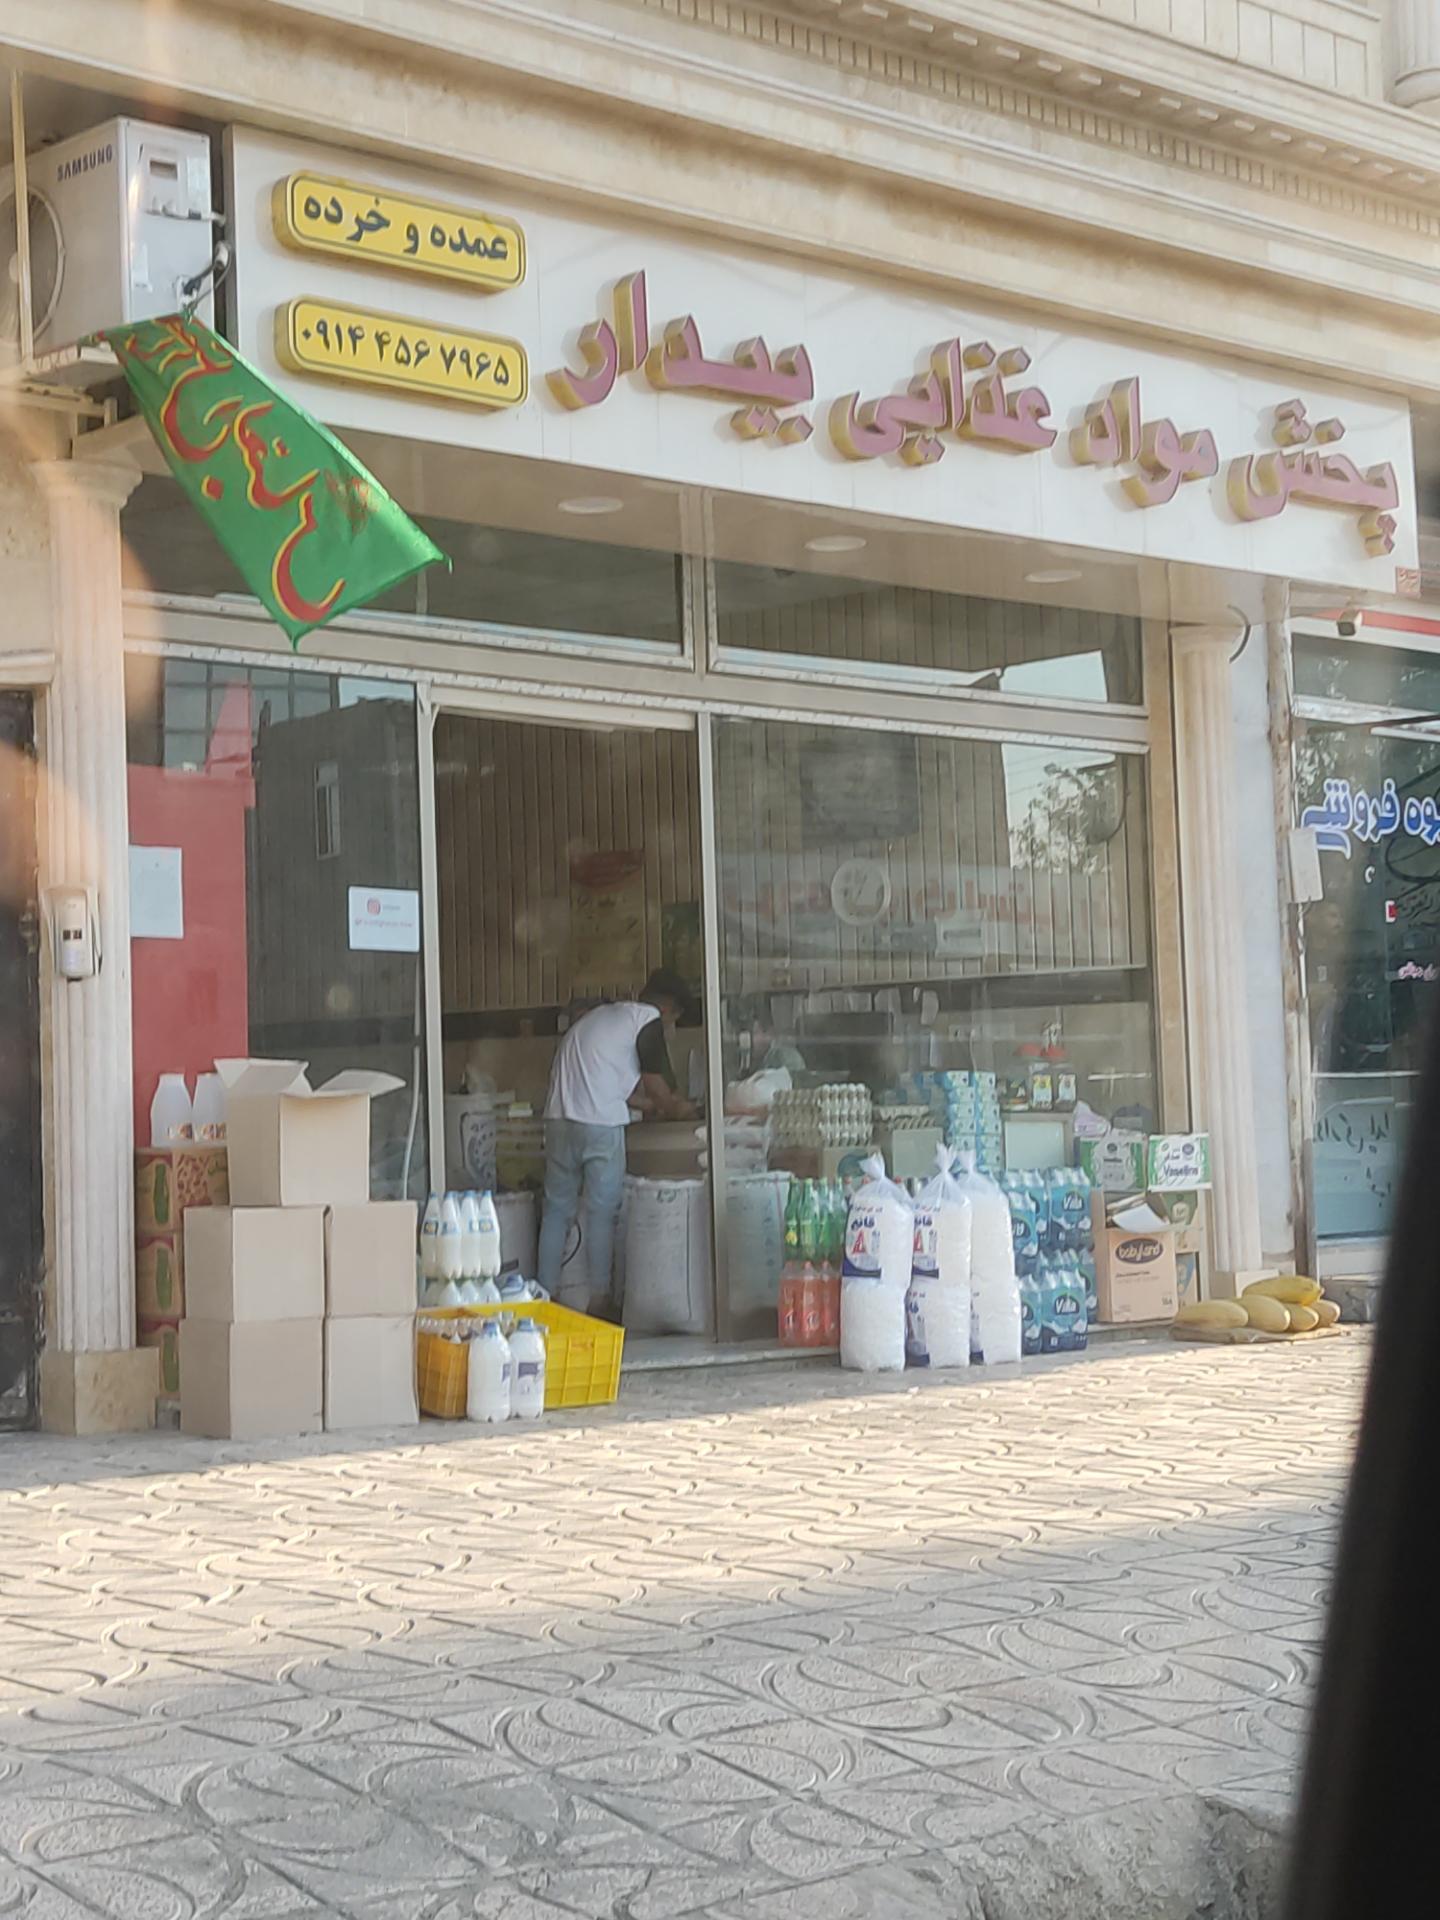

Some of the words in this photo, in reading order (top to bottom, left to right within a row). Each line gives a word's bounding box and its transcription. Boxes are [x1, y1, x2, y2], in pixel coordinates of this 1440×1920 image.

[57, 144, 113, 183] SAMSUNG
[303, 195, 392, 243] خرده
[402, 222, 421, 255] و
[429, 223, 509, 261] عمده
[545, 268, 815, 445] بیدار
[828, 336, 1058, 468] غذایی
[1070, 376, 1219, 508] مواد
[1227, 398, 1399, 558] پخش
[1301, 777, 1401, 860] فروشی
[1404, 797, 1440, 846] وه
